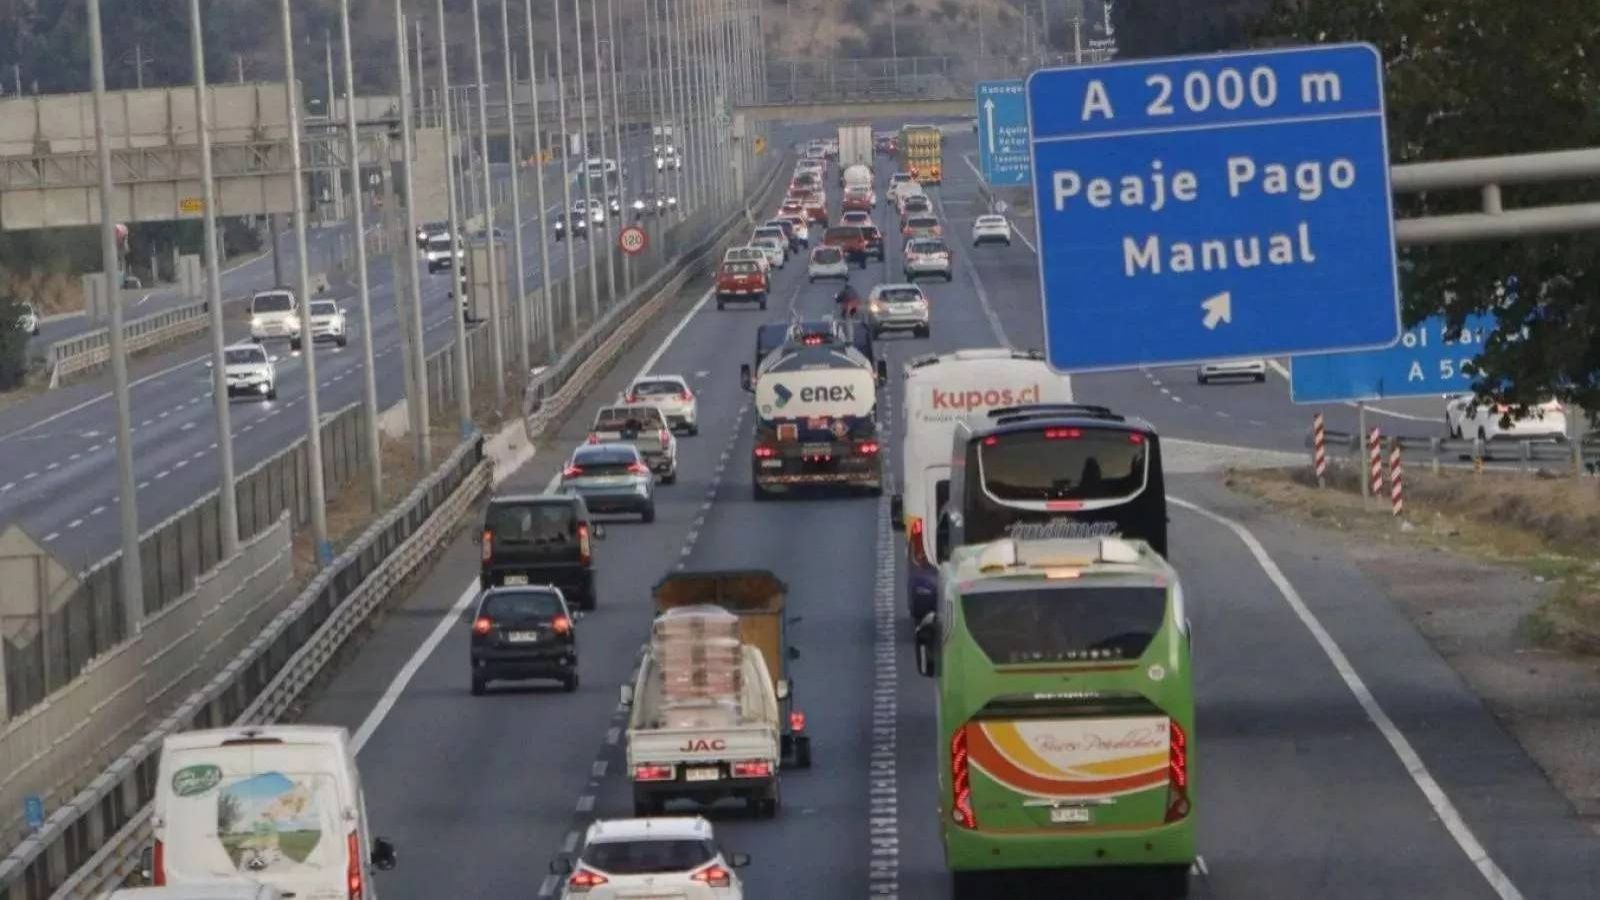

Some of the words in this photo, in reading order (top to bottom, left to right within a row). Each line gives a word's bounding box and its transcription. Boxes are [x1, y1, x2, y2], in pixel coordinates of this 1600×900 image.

[1081, 79, 1114, 121] A
[1146, 66, 1277, 115] 2000
[1301, 70, 1341, 102] m
[1052, 160, 1198, 211] Peaje
[1227, 157, 1355, 200] Pago
[625, 233, 642, 246] 120
[1123, 221, 1315, 277] Manual
[1408, 361, 1424, 382] A
[800, 384, 855, 402] enex
[932, 384, 1040, 412] kupos.cl
[680, 739, 726, 752] JAC
